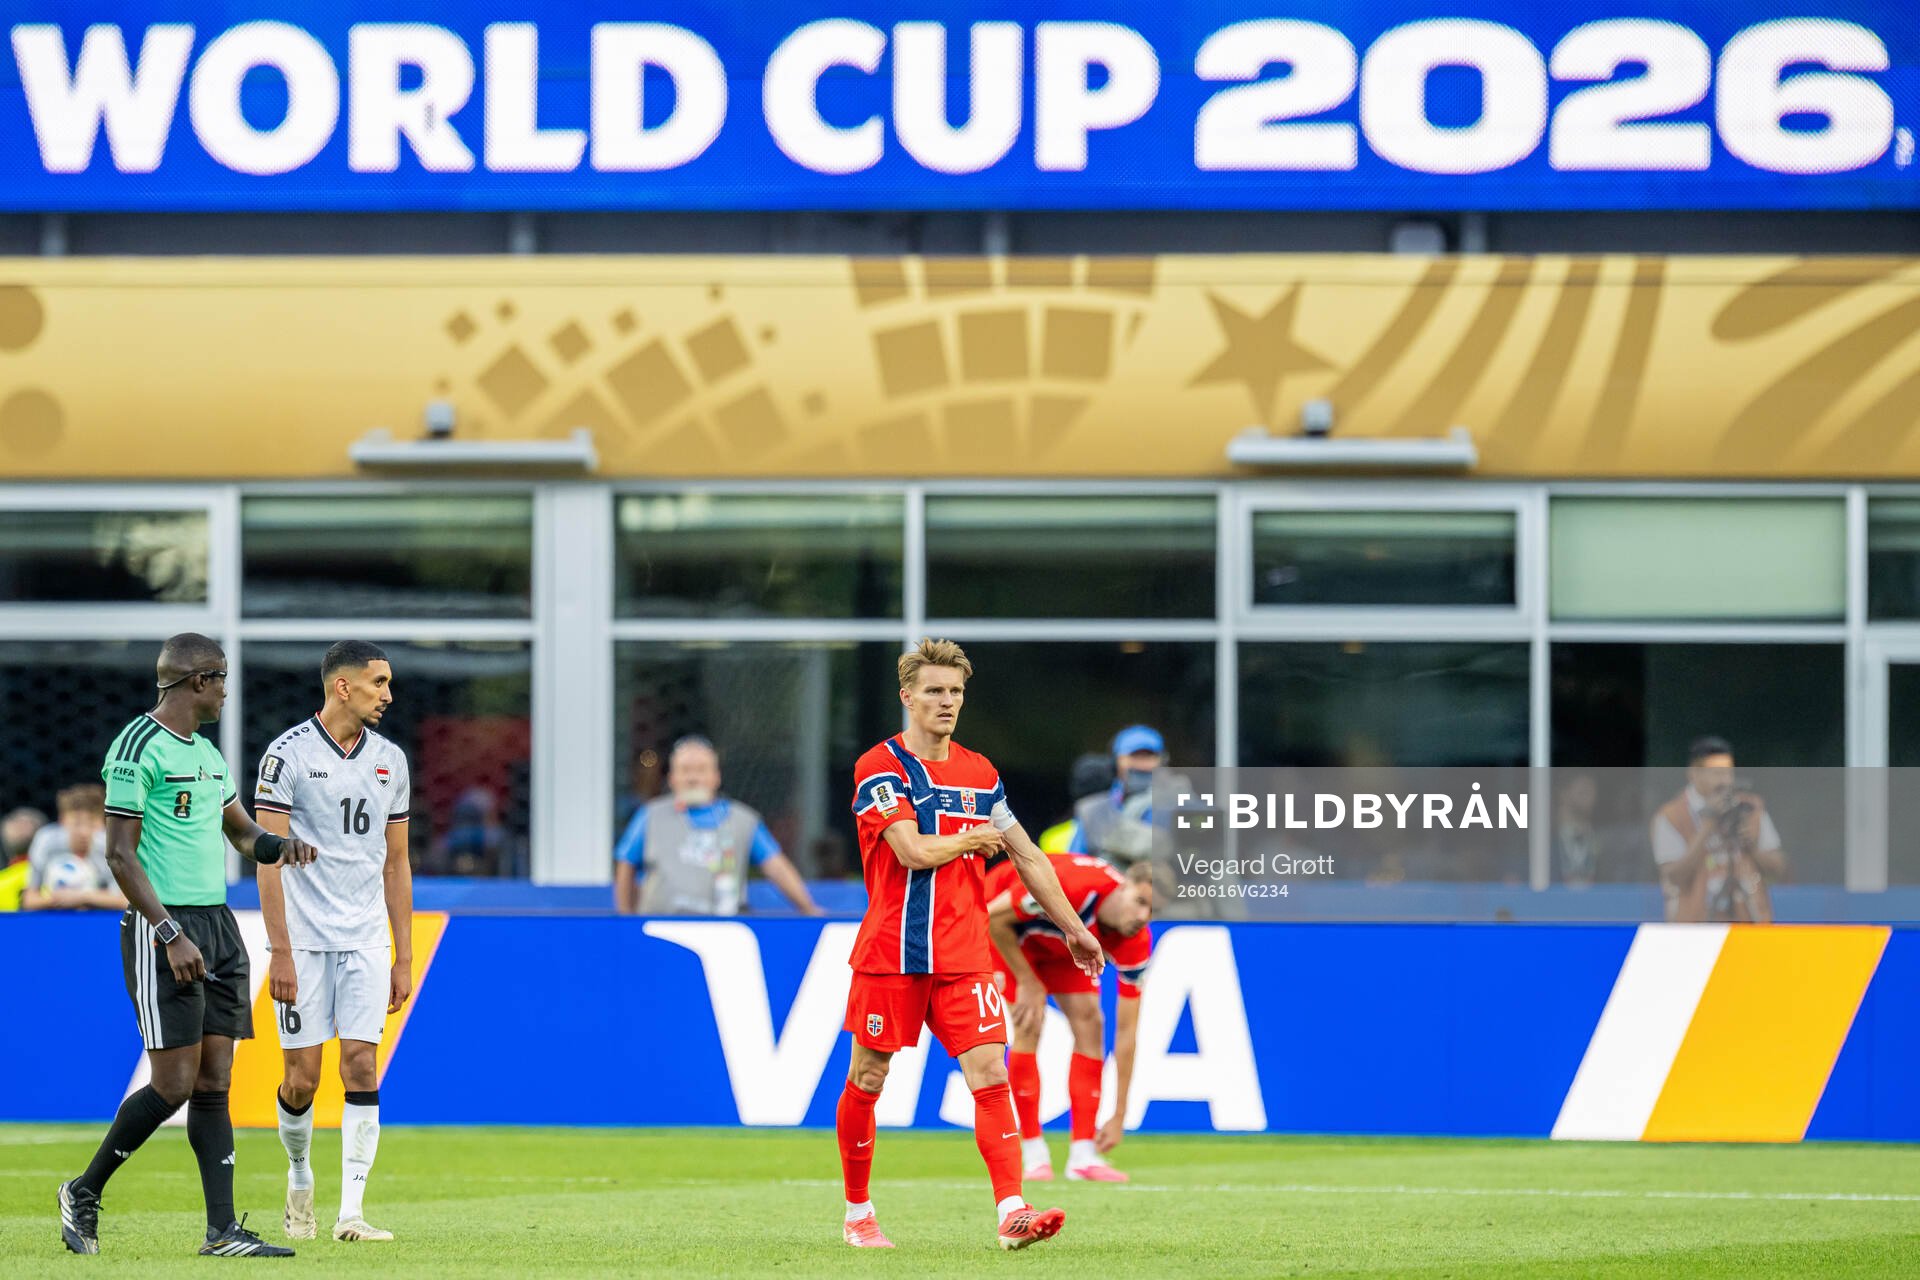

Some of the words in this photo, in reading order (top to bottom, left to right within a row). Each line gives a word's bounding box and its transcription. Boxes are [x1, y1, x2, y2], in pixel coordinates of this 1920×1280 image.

[10, 20, 728, 176] WORLD
[761, 19, 1161, 175] CUP
[1193, 18, 1894, 175] 2026
[113, 766, 135, 777] FIFA
[309, 771, 328, 779] JAKO
[340, 797, 371, 835] 16
[971, 982, 1001, 1018] 10
[643, 921, 1267, 1132] VA
